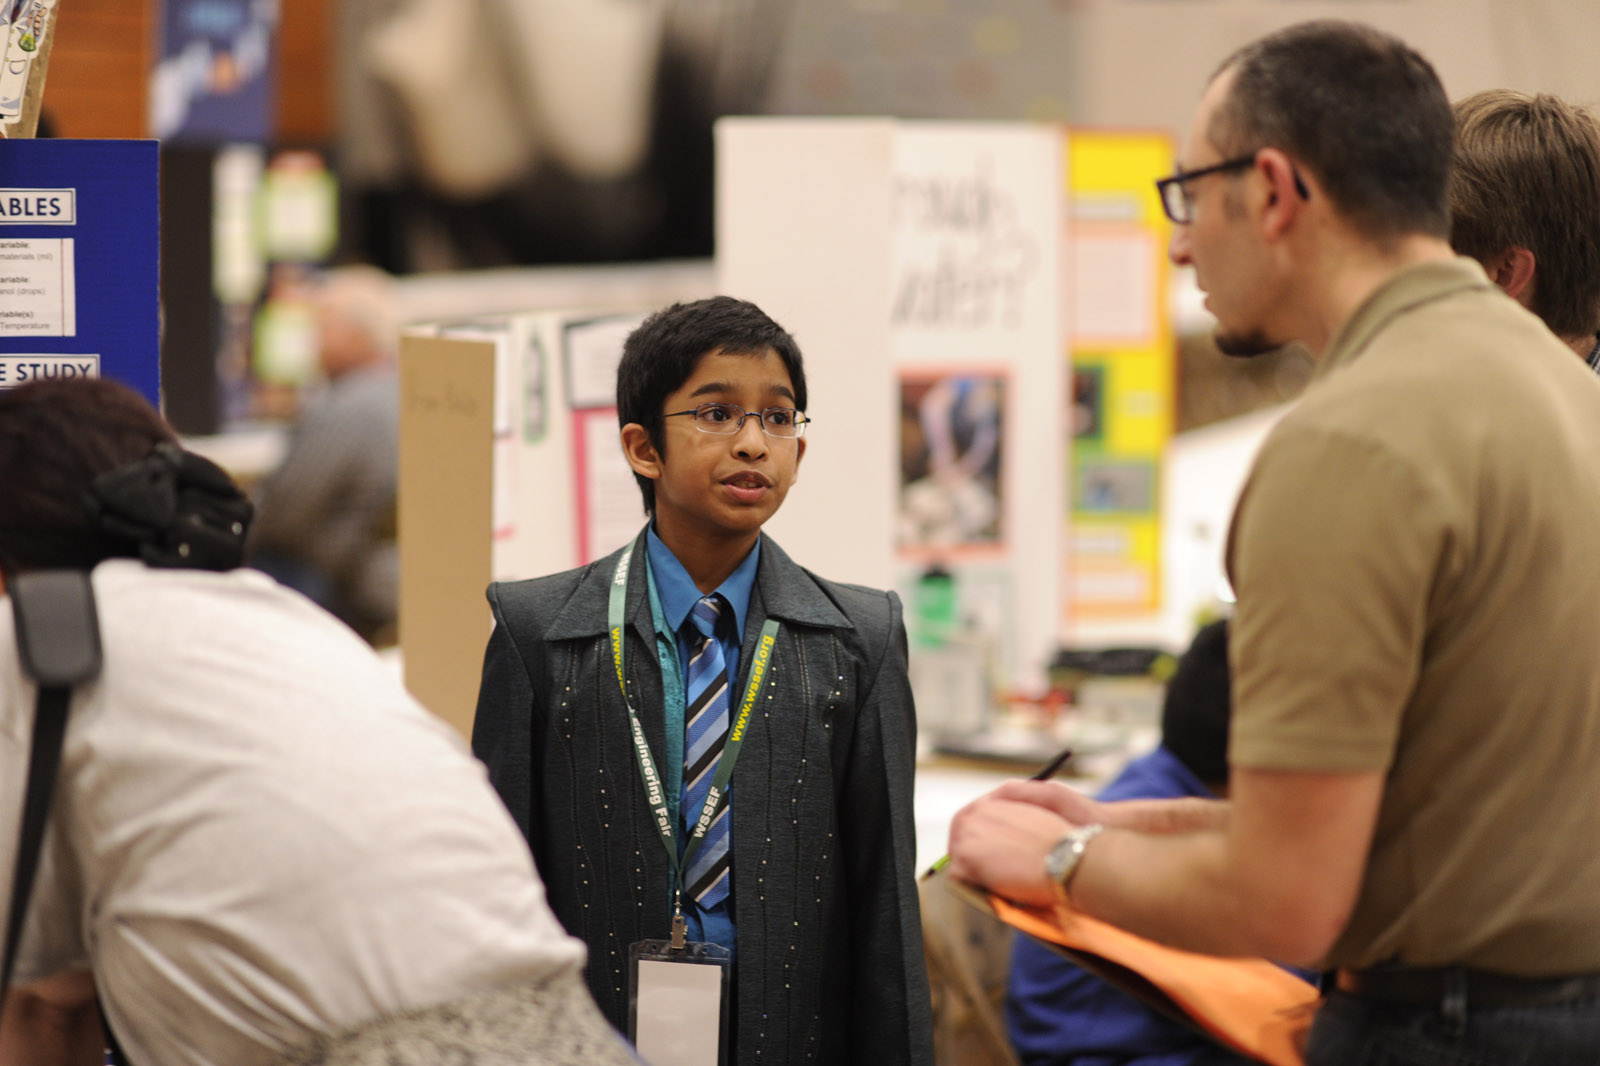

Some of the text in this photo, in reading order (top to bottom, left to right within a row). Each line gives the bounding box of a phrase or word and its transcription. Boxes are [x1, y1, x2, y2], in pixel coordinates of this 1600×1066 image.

[16, 363, 91, 383] STUDY
[731, 633, 776, 743] www.wssef.org
[631, 717, 672, 838] Engineering Fair
[693, 786, 721, 838] WSSEF
